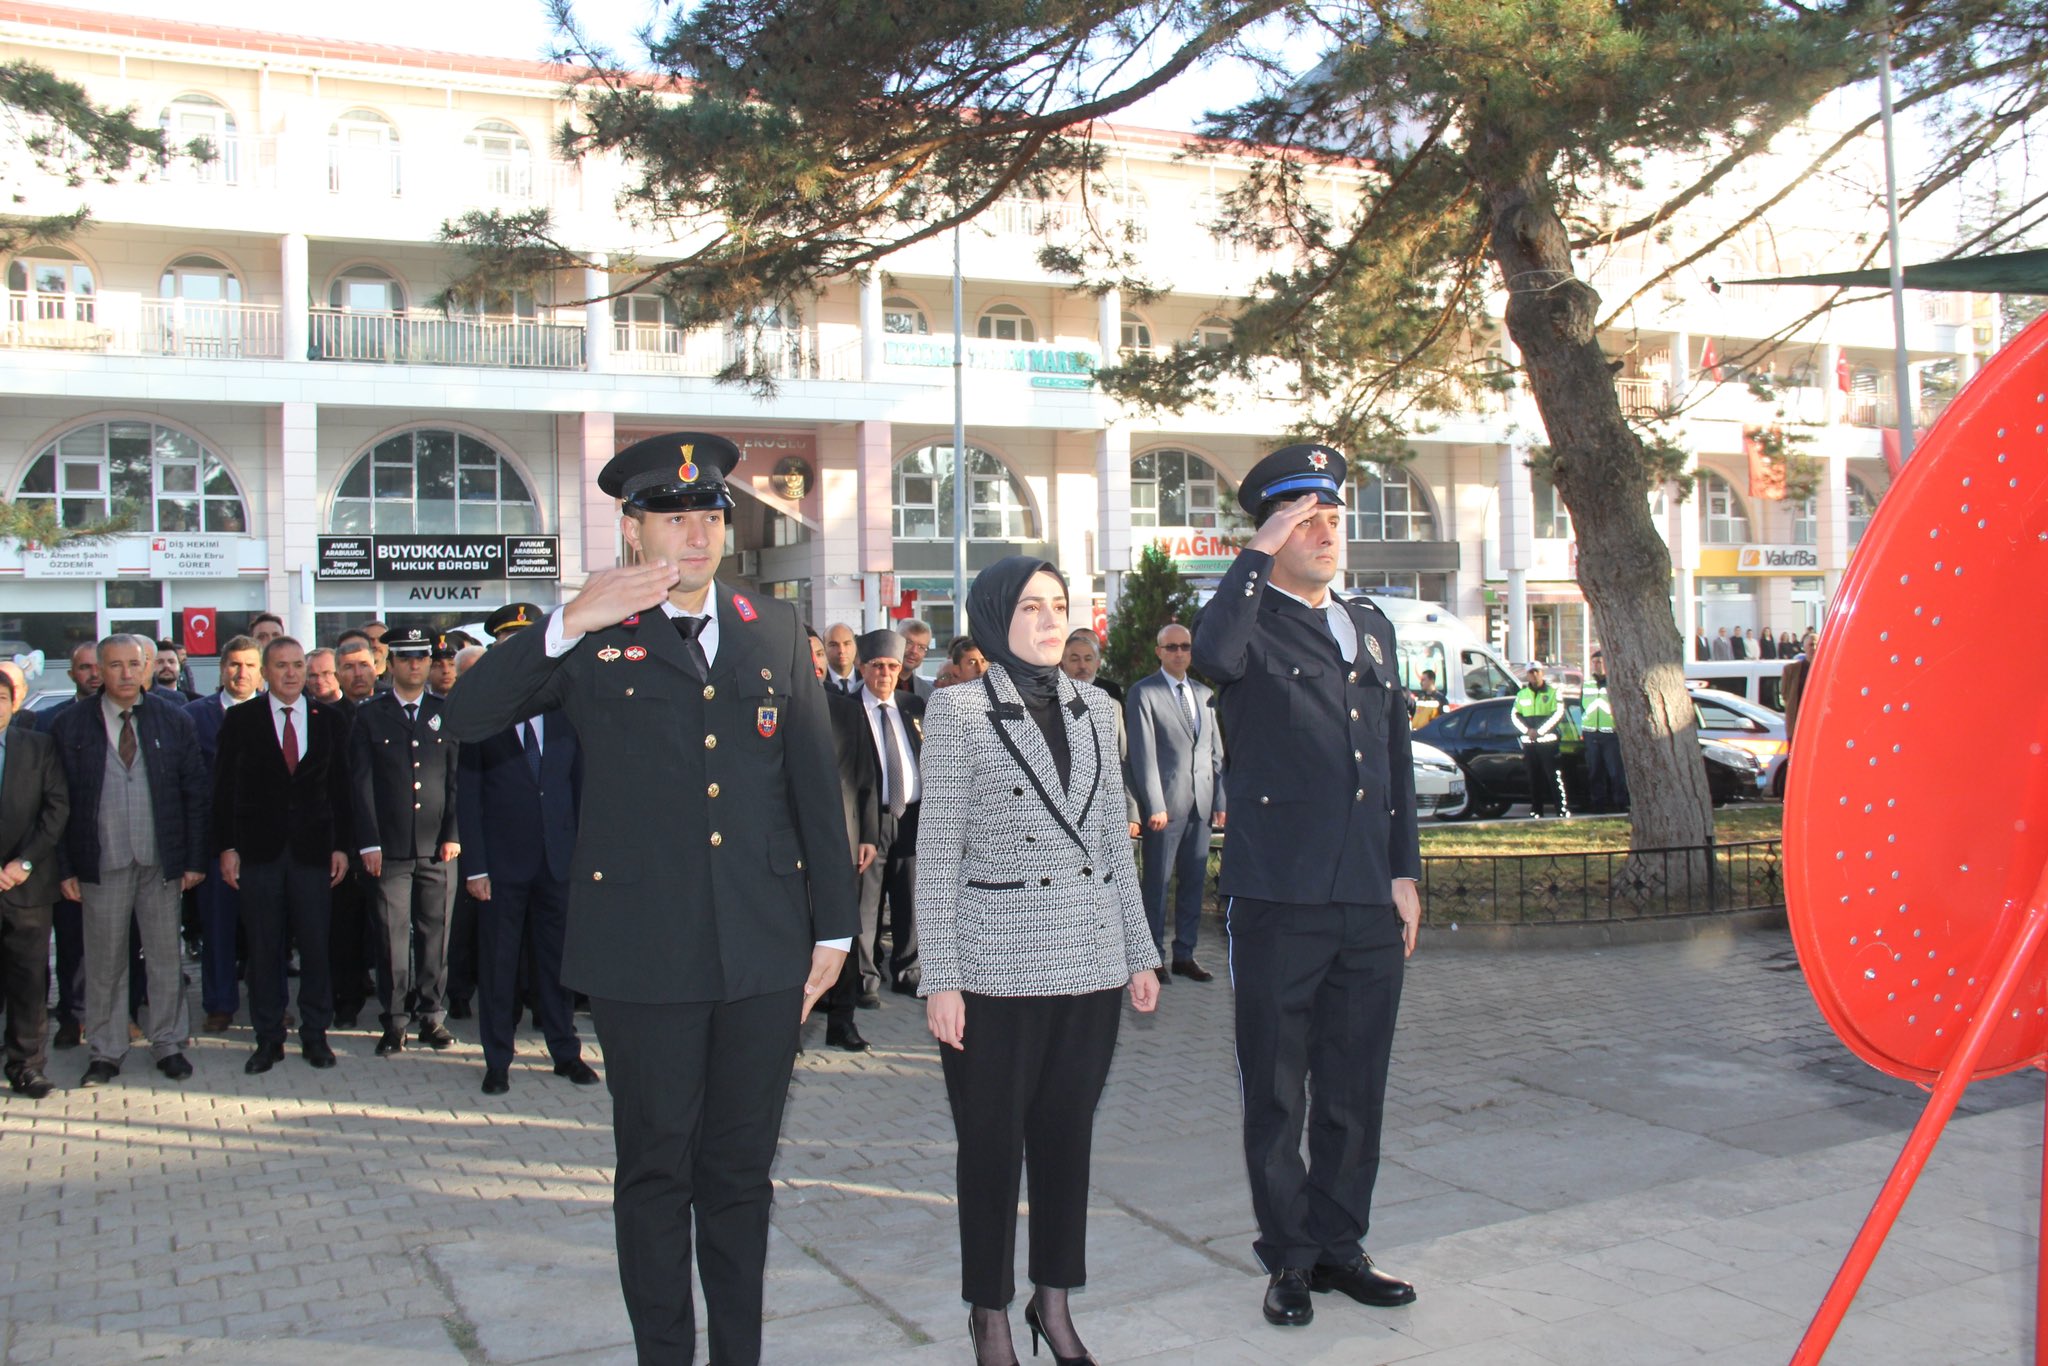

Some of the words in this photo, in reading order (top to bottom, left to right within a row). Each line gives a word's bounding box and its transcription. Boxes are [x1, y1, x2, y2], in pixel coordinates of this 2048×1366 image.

[884, 341, 960, 368] BEREKE
[169, 541, 184, 549] DİŞ
[1160, 529, 1244, 557] YAĞM
[50, 551, 80, 559] Ahmet
[83, 551, 109, 560] Şahin
[377, 545, 502, 559] BÜYÜKKALAYCI
[516, 558, 549, 566] Selahattin
[1765, 549, 1817, 567] VakıfBa
[49, 560, 94, 569] ÖZDEMİR
[178, 561, 211, 569] GÜRER
[333, 561, 358, 569] Zeynep
[391, 561, 435, 571] HUKUK
[437, 560, 490, 570] BÜROSU
[508, 565, 556, 573] BÜYÜKKALAYCI
[320, 568, 371, 576] BÜYÜKKALAYCI
[408, 586, 482, 600] AVUKAT
